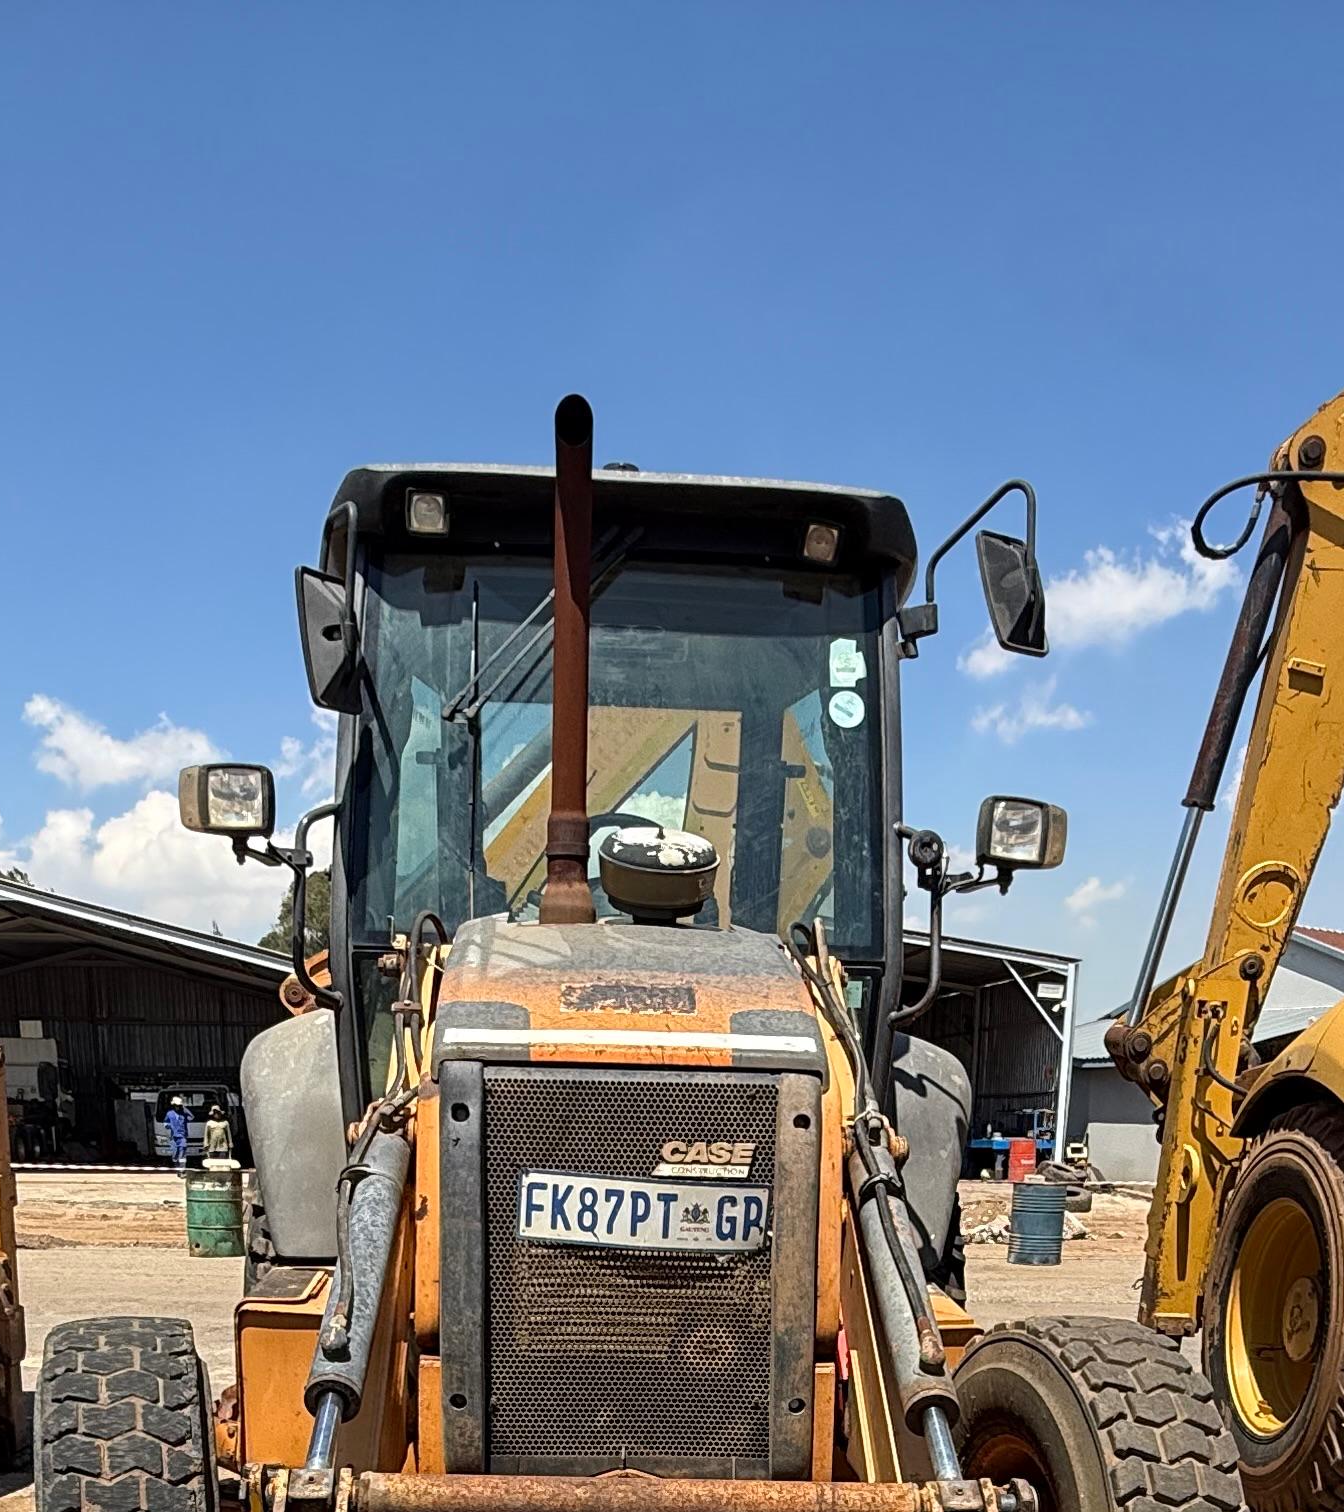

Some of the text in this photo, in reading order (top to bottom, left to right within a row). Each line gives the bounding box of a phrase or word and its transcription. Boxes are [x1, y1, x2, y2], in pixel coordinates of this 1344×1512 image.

[661, 1141, 756, 1164] CASE
[671, 1166, 745, 1176] CONSTRUCTION
[525, 1182, 678, 1240] FK87PT
